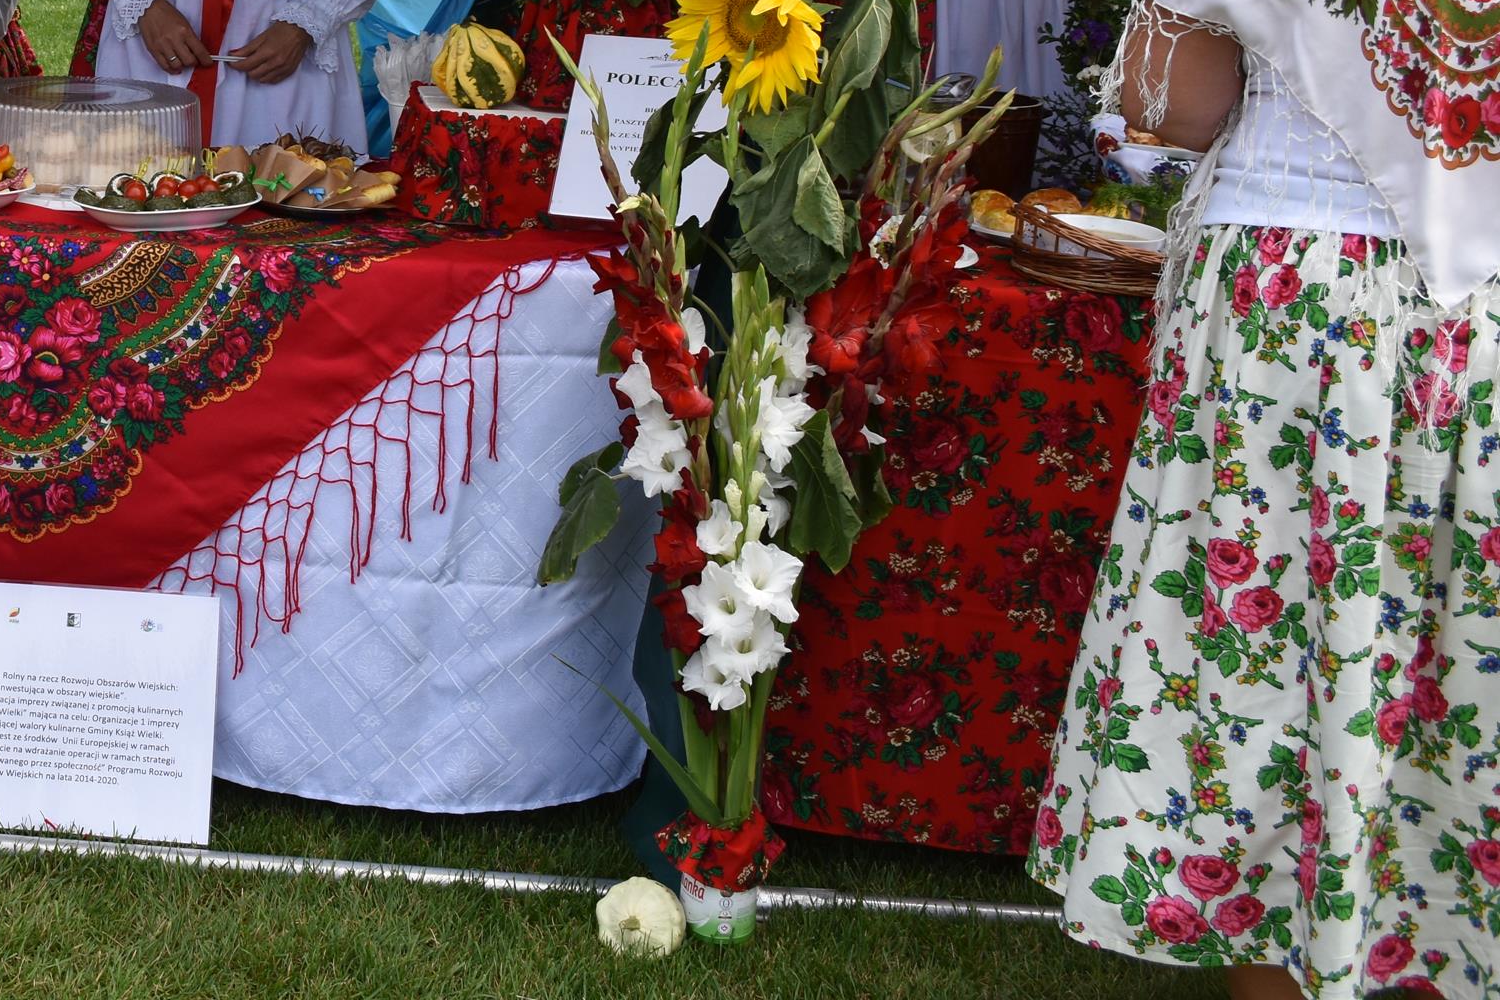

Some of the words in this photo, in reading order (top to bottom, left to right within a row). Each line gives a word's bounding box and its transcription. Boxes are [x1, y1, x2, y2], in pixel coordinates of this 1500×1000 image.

[3, 671, 25, 682] Rolny
[61, 675, 95, 687] Rozwoju
[96, 678, 136, 688] Obszarów
[56, 687, 87, 698] obszary
[17, 697, 49, 708] imprezy
[51, 699, 90, 711] związanej
[97, 704, 135, 715] promocją
[137, 705, 184, 717] kulinarnych
[29, 710, 58, 720] mająca
[92, 714, 139, 727] Organizacje
[141, 718, 145, 726] 1
[147, 718, 180, 730] imprezy
[19, 721, 47, 732] walory
[48, 723, 86, 734] kulinarne
[87, 726, 114, 737] Gminy
[115, 728, 135, 739] Książ
[24, 733, 58, 744] środków
[62, 736, 78, 745] Unii
[80, 737, 129, 751] Europejskiej
[139, 743, 170, 752] ramach
[24, 746, 66, 757] wdrażanie
[68, 750, 100, 761] operacji
[110, 754, 141, 762] ramach
[142, 756, 176, 766] strategii
[6, 769, 44, 779] Wiejskich
[57, 772, 73, 782] lata
[108, 764, 147, 775] Programu
[148, 767, 183, 779] Rozwoju
